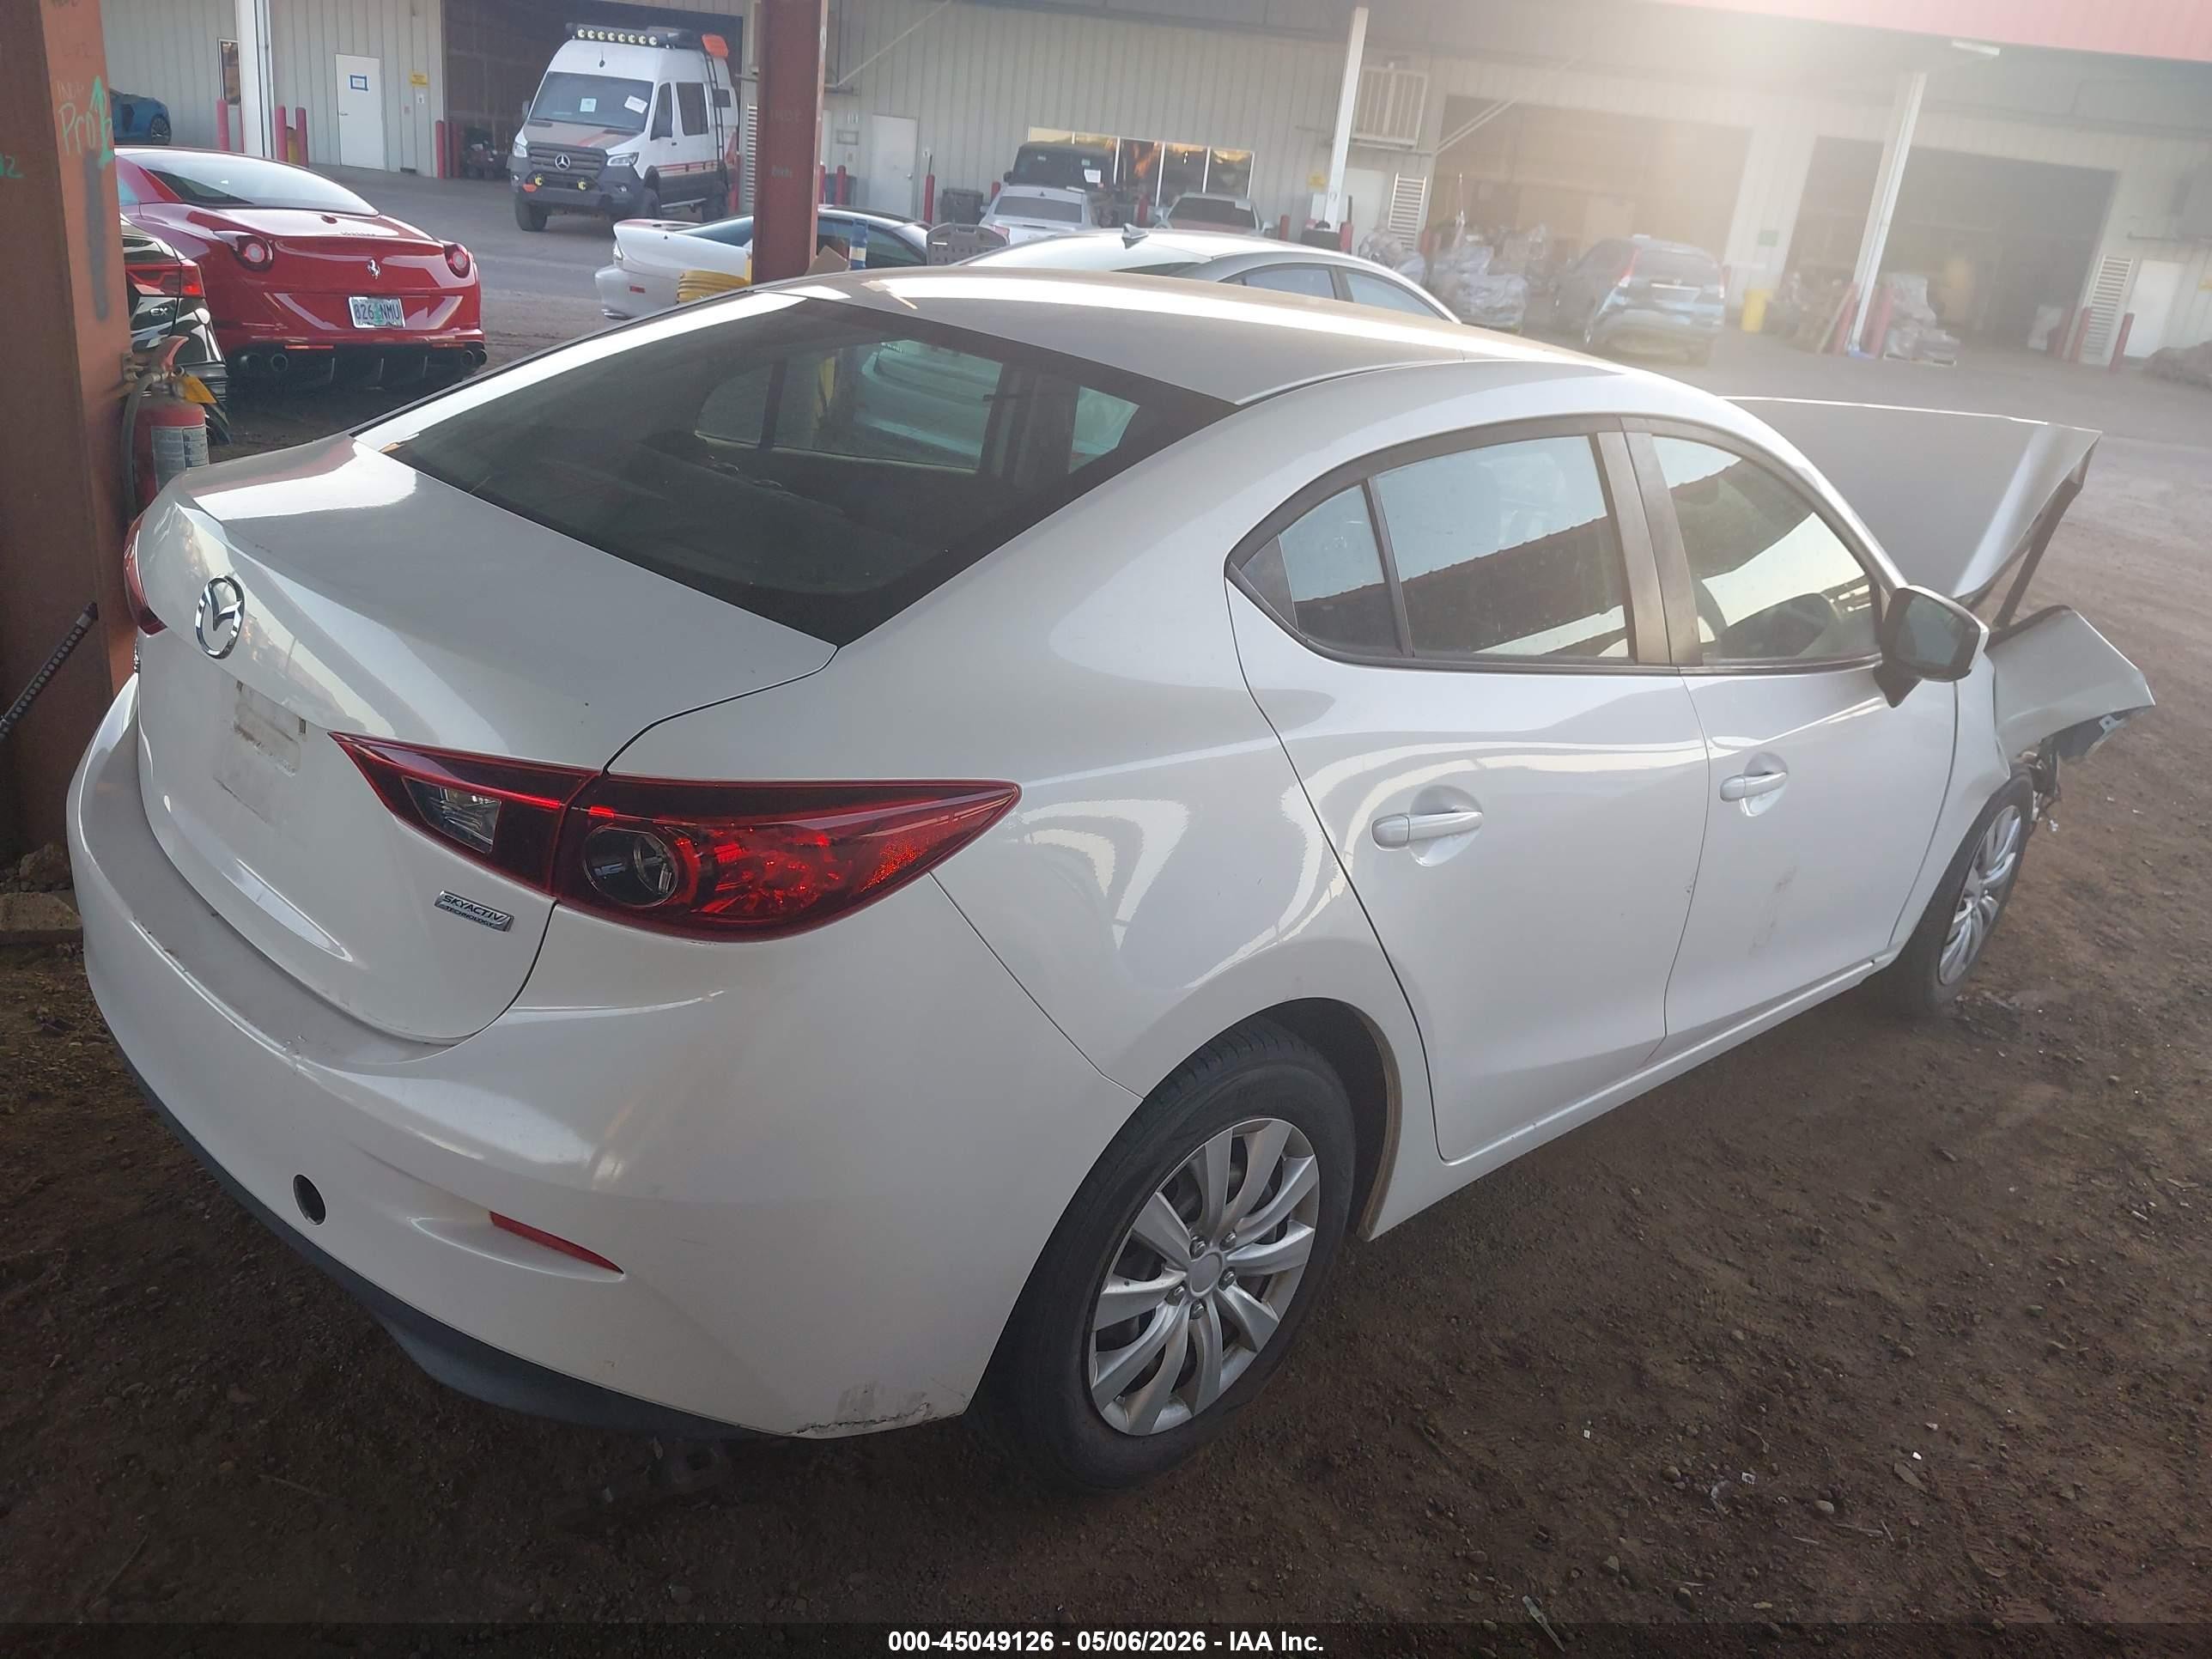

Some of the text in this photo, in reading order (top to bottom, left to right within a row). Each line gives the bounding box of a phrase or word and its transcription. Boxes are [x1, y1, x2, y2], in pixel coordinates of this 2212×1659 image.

[149, 307, 168, 317] EX
[380, 302, 400, 320] NMU
[442, 894, 505, 922] SKYACTIV
